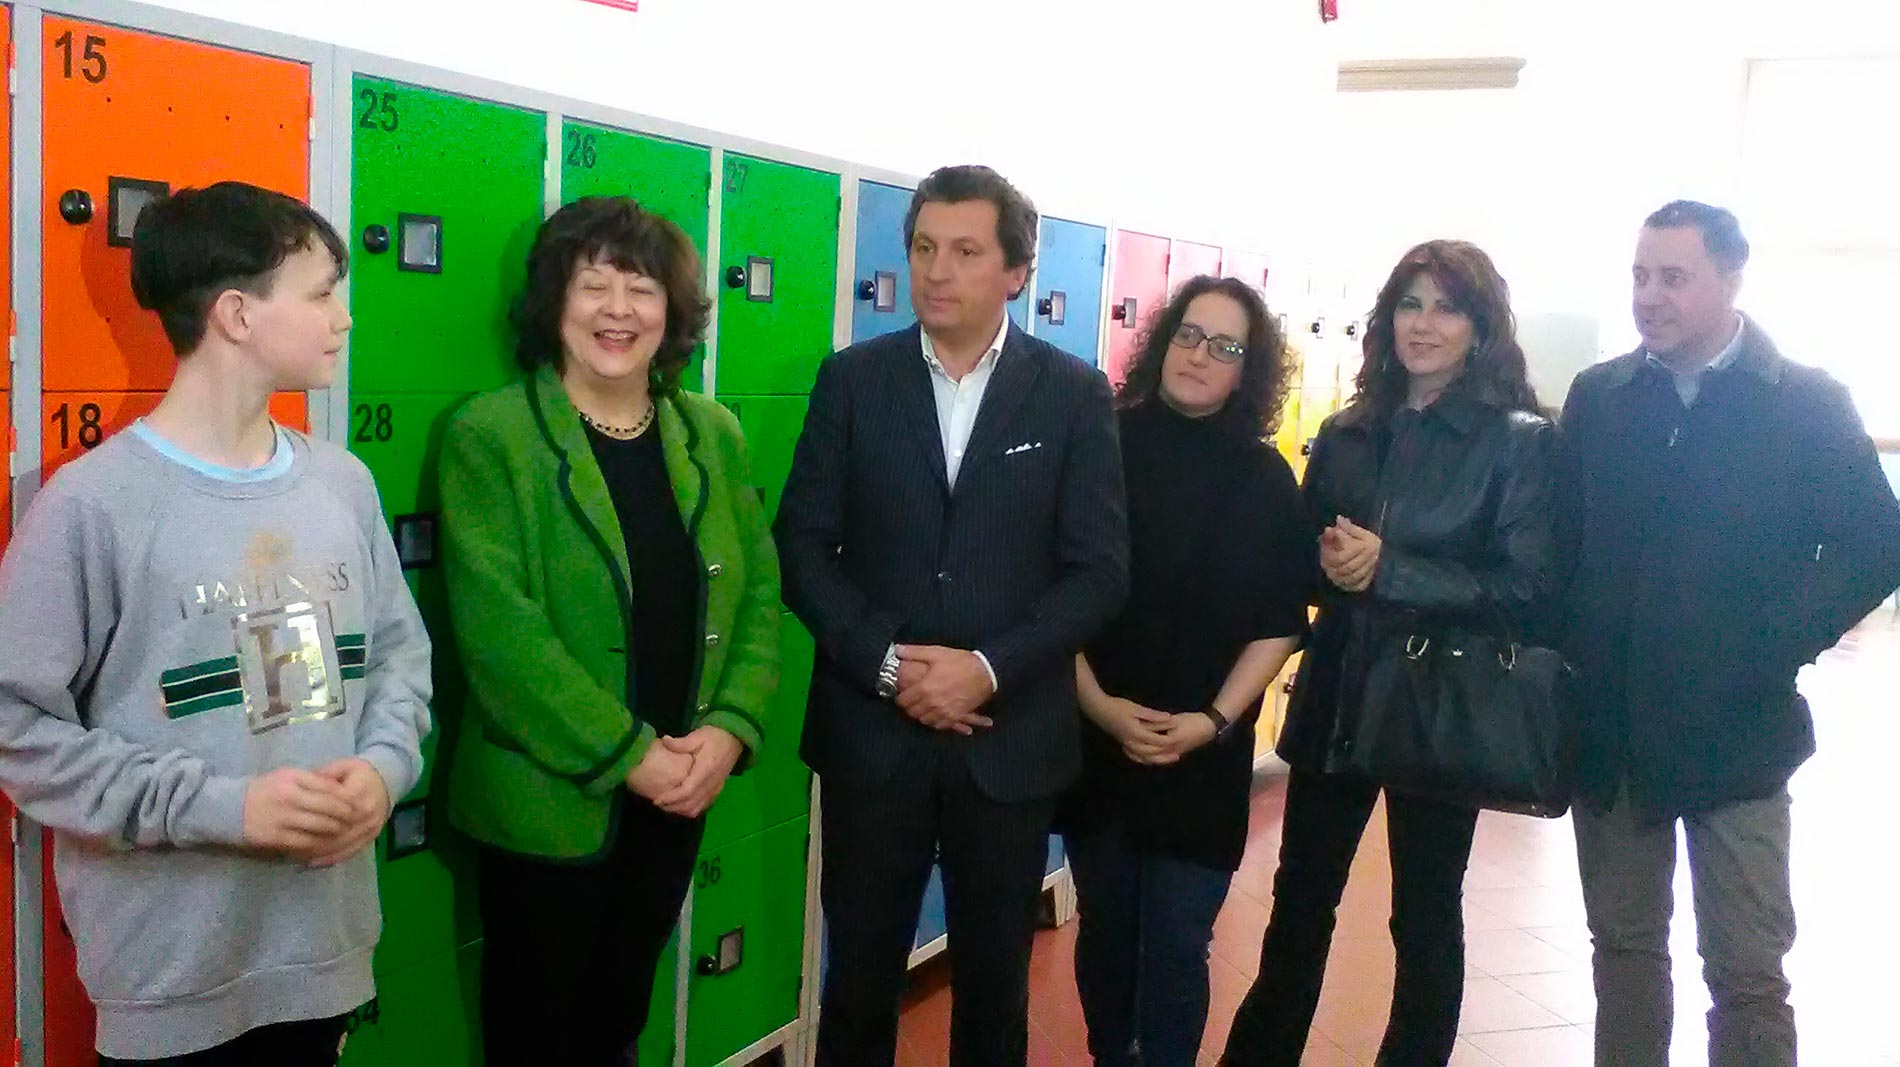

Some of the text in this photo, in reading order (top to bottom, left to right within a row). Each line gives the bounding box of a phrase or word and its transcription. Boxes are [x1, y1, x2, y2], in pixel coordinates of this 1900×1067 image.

[54, 31, 108, 84] 15
[358, 89, 399, 132] 25
[566, 130, 597, 169] 26
[725, 160, 750, 194] 27
[51, 403, 103, 450] 18
[355, 403, 393, 443] 28
[697, 855, 721, 889] 36
